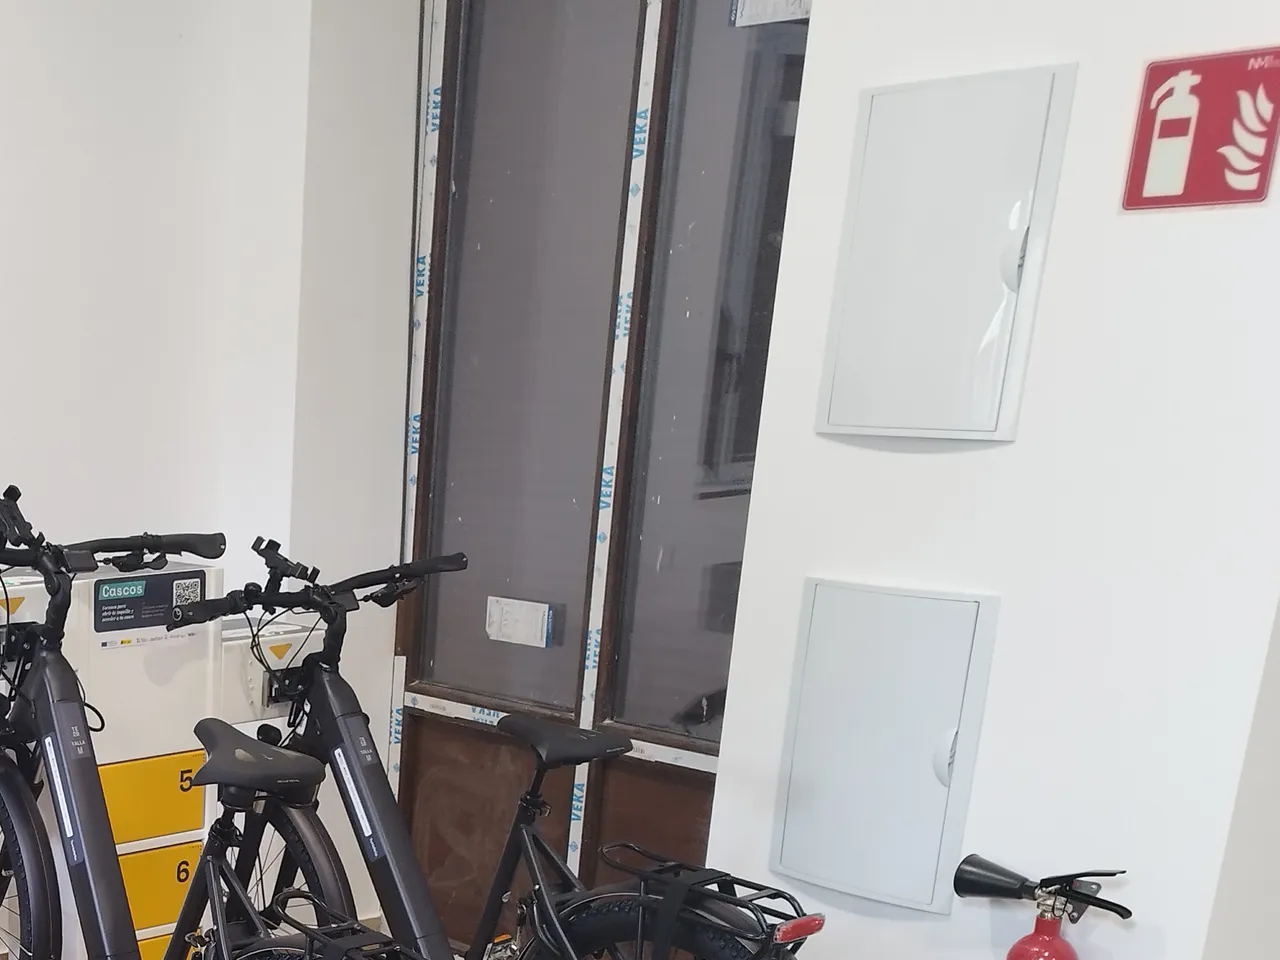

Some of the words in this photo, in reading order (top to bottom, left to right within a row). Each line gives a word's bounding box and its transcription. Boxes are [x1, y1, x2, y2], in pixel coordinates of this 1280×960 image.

[632, 108, 649, 159] VEKA
[415, 255, 427, 298] VEKA
[410, 414, 421, 455] VEKA
[599, 466, 615, 510] VEKA
[102, 585, 143, 598] Cascos
[393, 708, 403, 744] VEKA
[179, 769, 193, 792] 5
[571, 783, 586, 821] VEKA
[176, 860, 190, 883] 6
